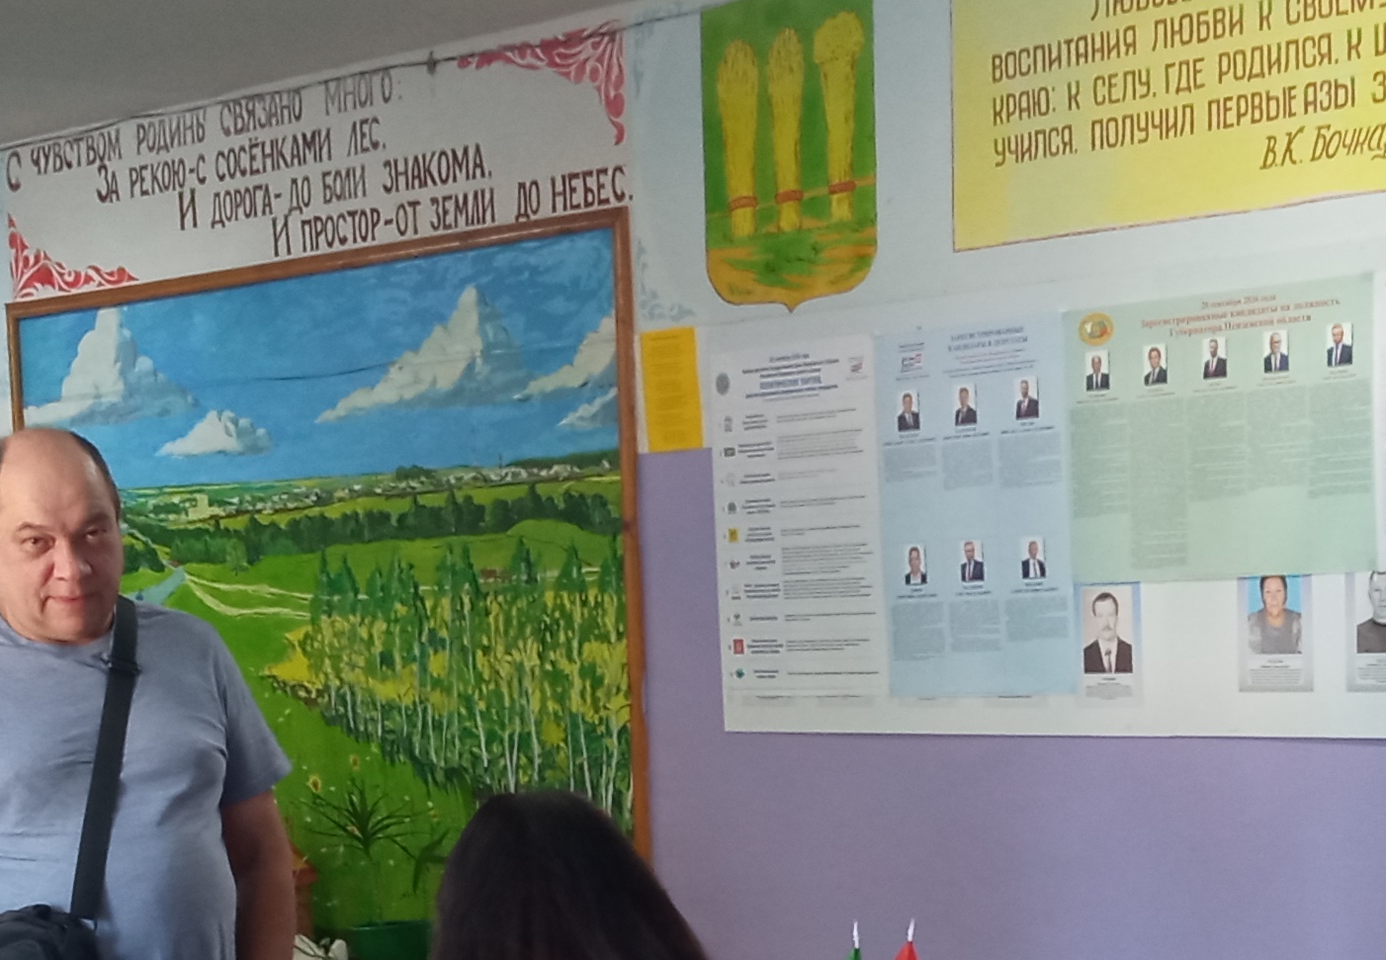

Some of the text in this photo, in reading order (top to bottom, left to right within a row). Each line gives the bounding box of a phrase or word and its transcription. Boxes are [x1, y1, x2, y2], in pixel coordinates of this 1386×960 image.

[991, 25, 1137, 84] ВОСПИТАНИЯ
[1151, 4, 1244, 52] ЛЮБВИ
[1258, 1, 1272, 31] К
[992, 86, 1057, 127] КРАЮ:
[1067, 80, 1081, 112] К
[1164, 57, 1206, 95] ГДЕ
[1346, 27, 1363, 62] К
[5, 152, 22, 193] С
[29, 128, 123, 176] ЧУВСТВОМ
[218, 89, 303, 137] СВЯЗАНО
[1090, 102, 1195, 152] ПОЛУЧИЛ
[1207, 85, 1298, 132] ПЕРВЫЕ
[1302, 75, 1356, 116] АЗЫ
[95, 164, 121, 204] ЗА
[215, 126, 333, 182] СОСЁНКАМИ
[177, 187, 198, 231] И
[287, 174, 312, 216] ДО
[321, 164, 367, 204] БОЛИ
[271, 212, 293, 258] И
[429, 186, 496, 232] ЗЕМЛИ
[514, 178, 541, 223] ДО
[550, 164, 634, 214] НЕБЕС.
